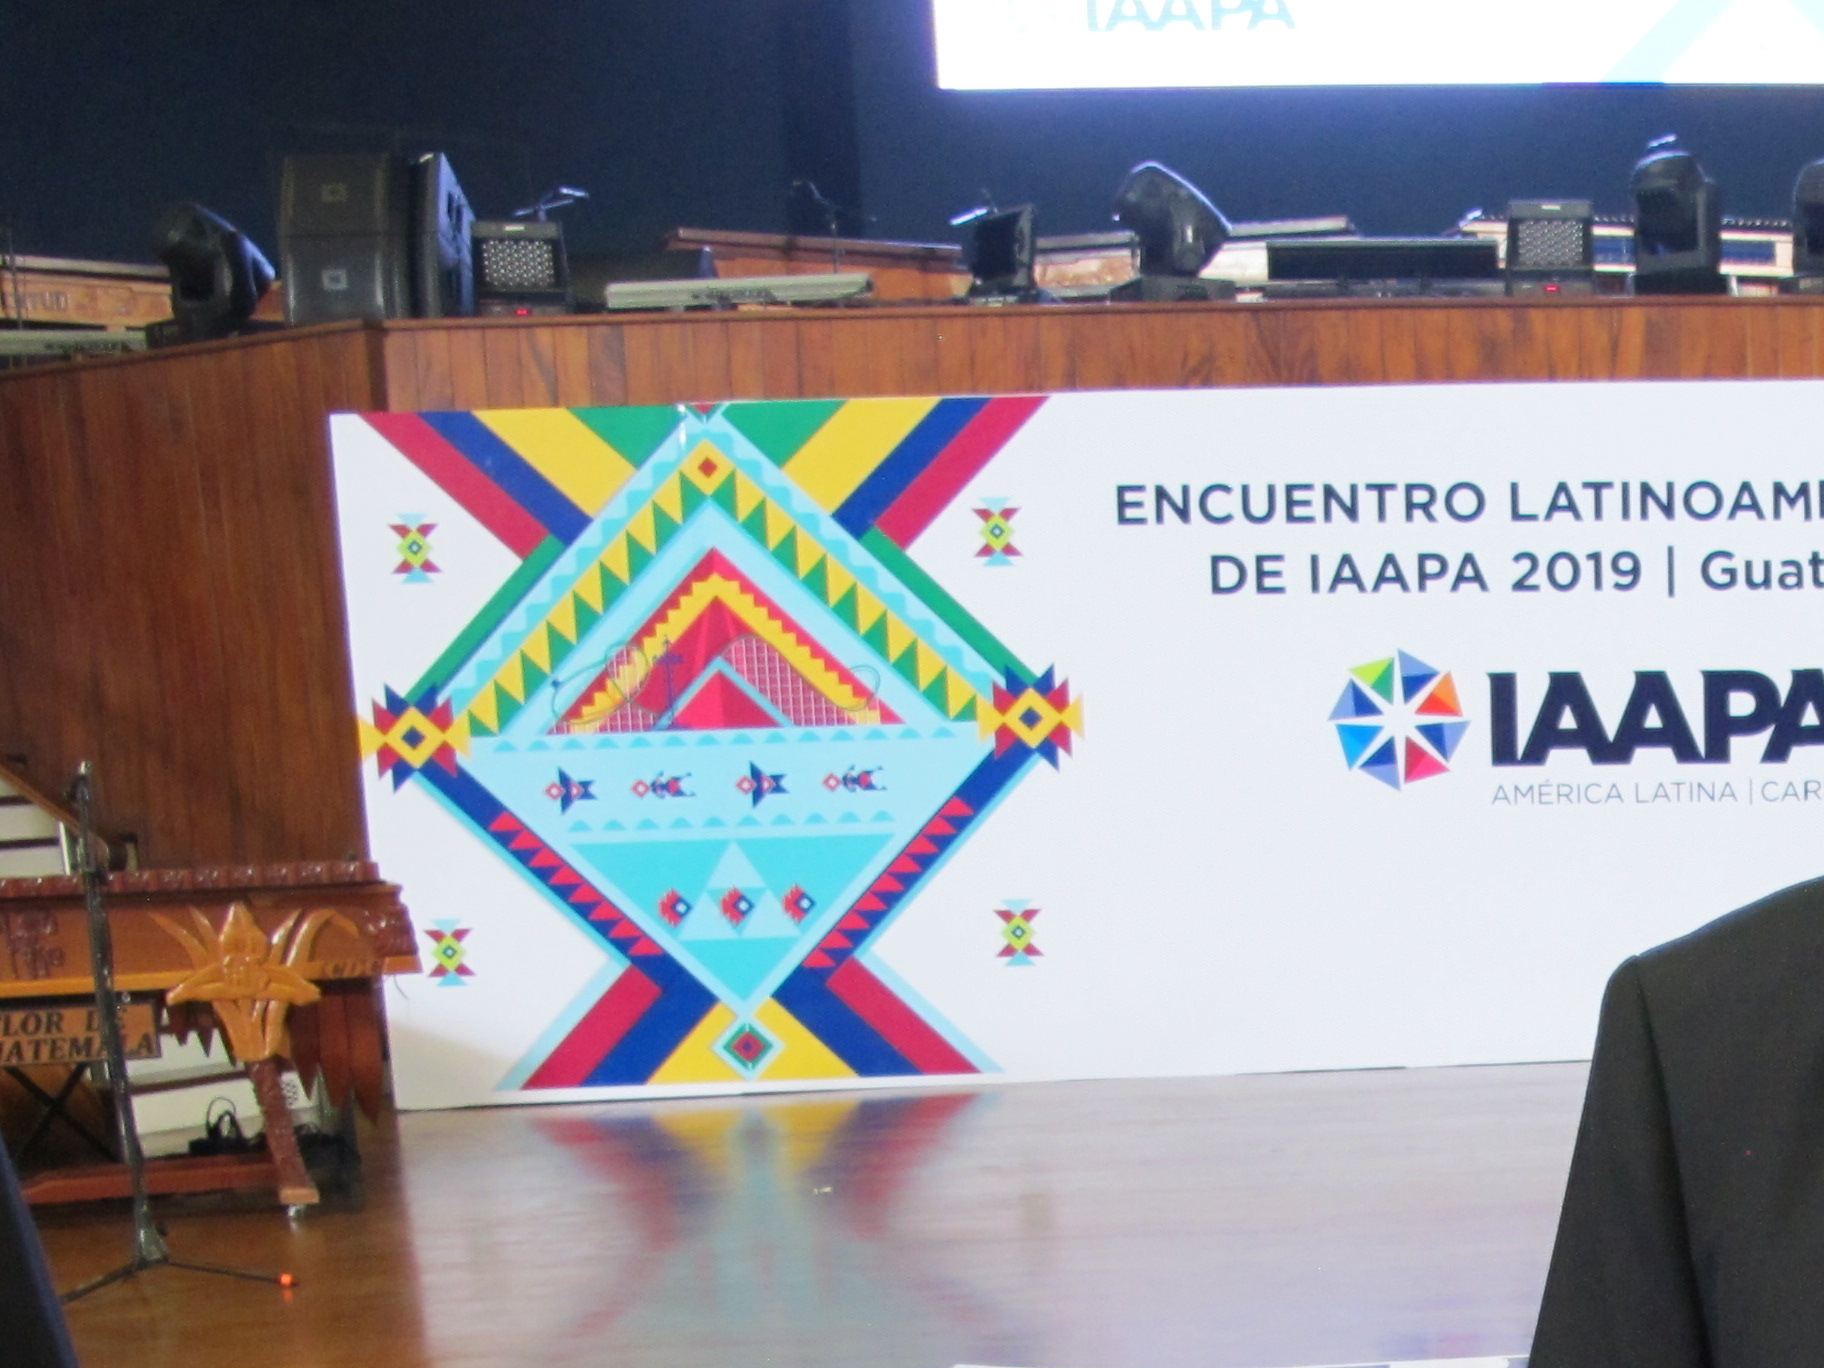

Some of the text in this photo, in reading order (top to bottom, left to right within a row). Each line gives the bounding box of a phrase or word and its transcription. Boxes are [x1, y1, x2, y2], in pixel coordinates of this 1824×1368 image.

[1115, 481, 1487, 526] ENCUENTRO
[1209, 552, 1287, 595] DE
[1309, 551, 1491, 594] IAAPA
[1510, 550, 1643, 593] 2019
[1490, 778, 1625, 806] AMÉRICA
[1634, 780, 1739, 804] LATINA
[0, 1008, 65, 1037] LOR
